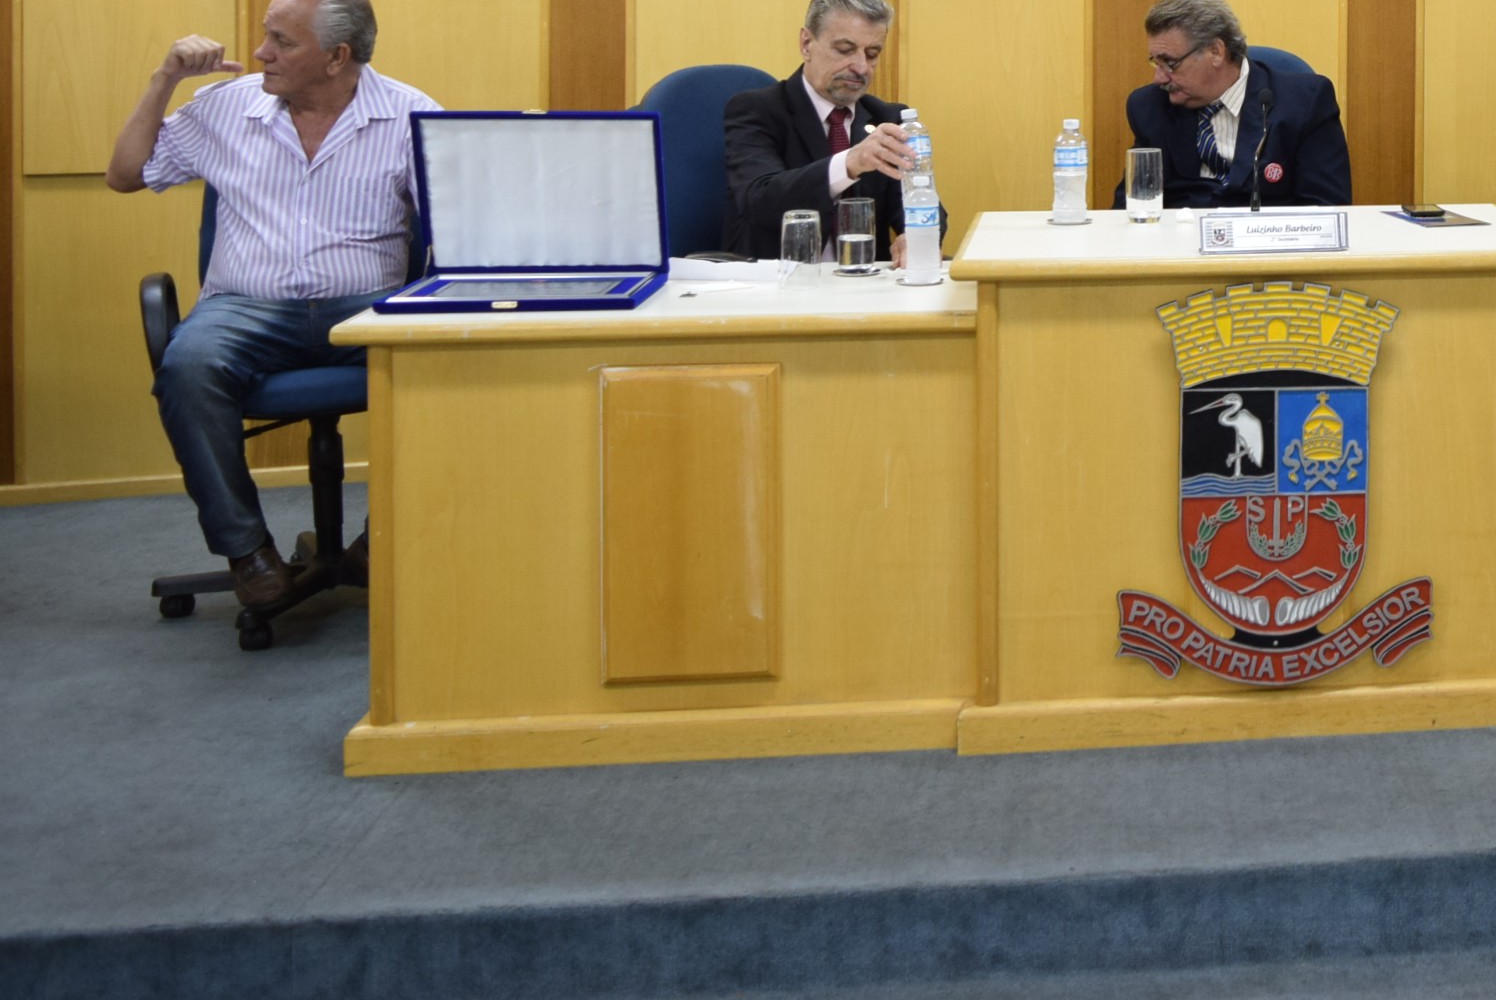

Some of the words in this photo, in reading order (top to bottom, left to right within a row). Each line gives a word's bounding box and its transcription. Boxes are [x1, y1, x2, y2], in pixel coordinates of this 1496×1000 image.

[1246, 224, 1283, 235] Luizinho
[1285, 223, 1322, 233] Barbeiro
[1128, 600, 1185, 640] PRO
[1181, 631, 1276, 679] PATRIA
[1282, 587, 1426, 679] EXCELSIOR
